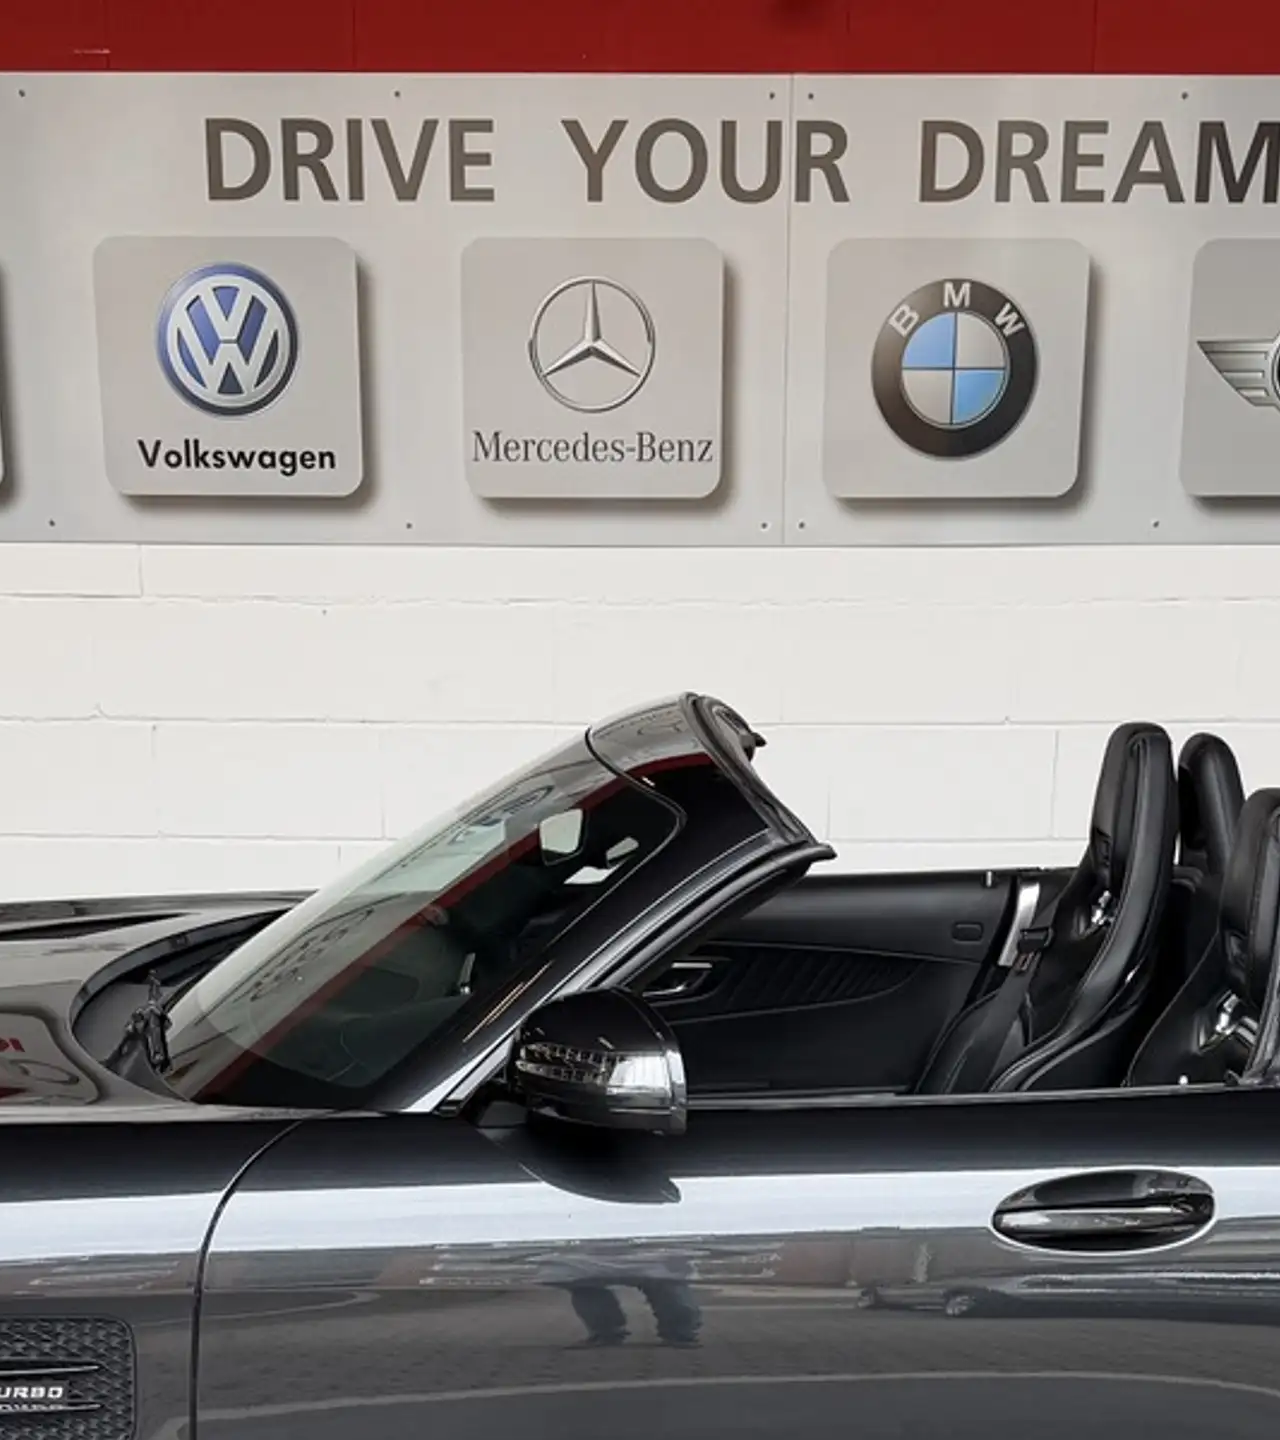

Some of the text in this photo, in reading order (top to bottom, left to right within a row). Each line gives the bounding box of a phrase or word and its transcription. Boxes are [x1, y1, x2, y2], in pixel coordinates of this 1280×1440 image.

[206, 118, 494, 201] DRIVE
[561, 119, 849, 204] YOUR
[888, 281, 1025, 337] BMW
[137, 438, 336, 476] Volkswagen
[473, 430, 713, 463] Mercedes-Benz
